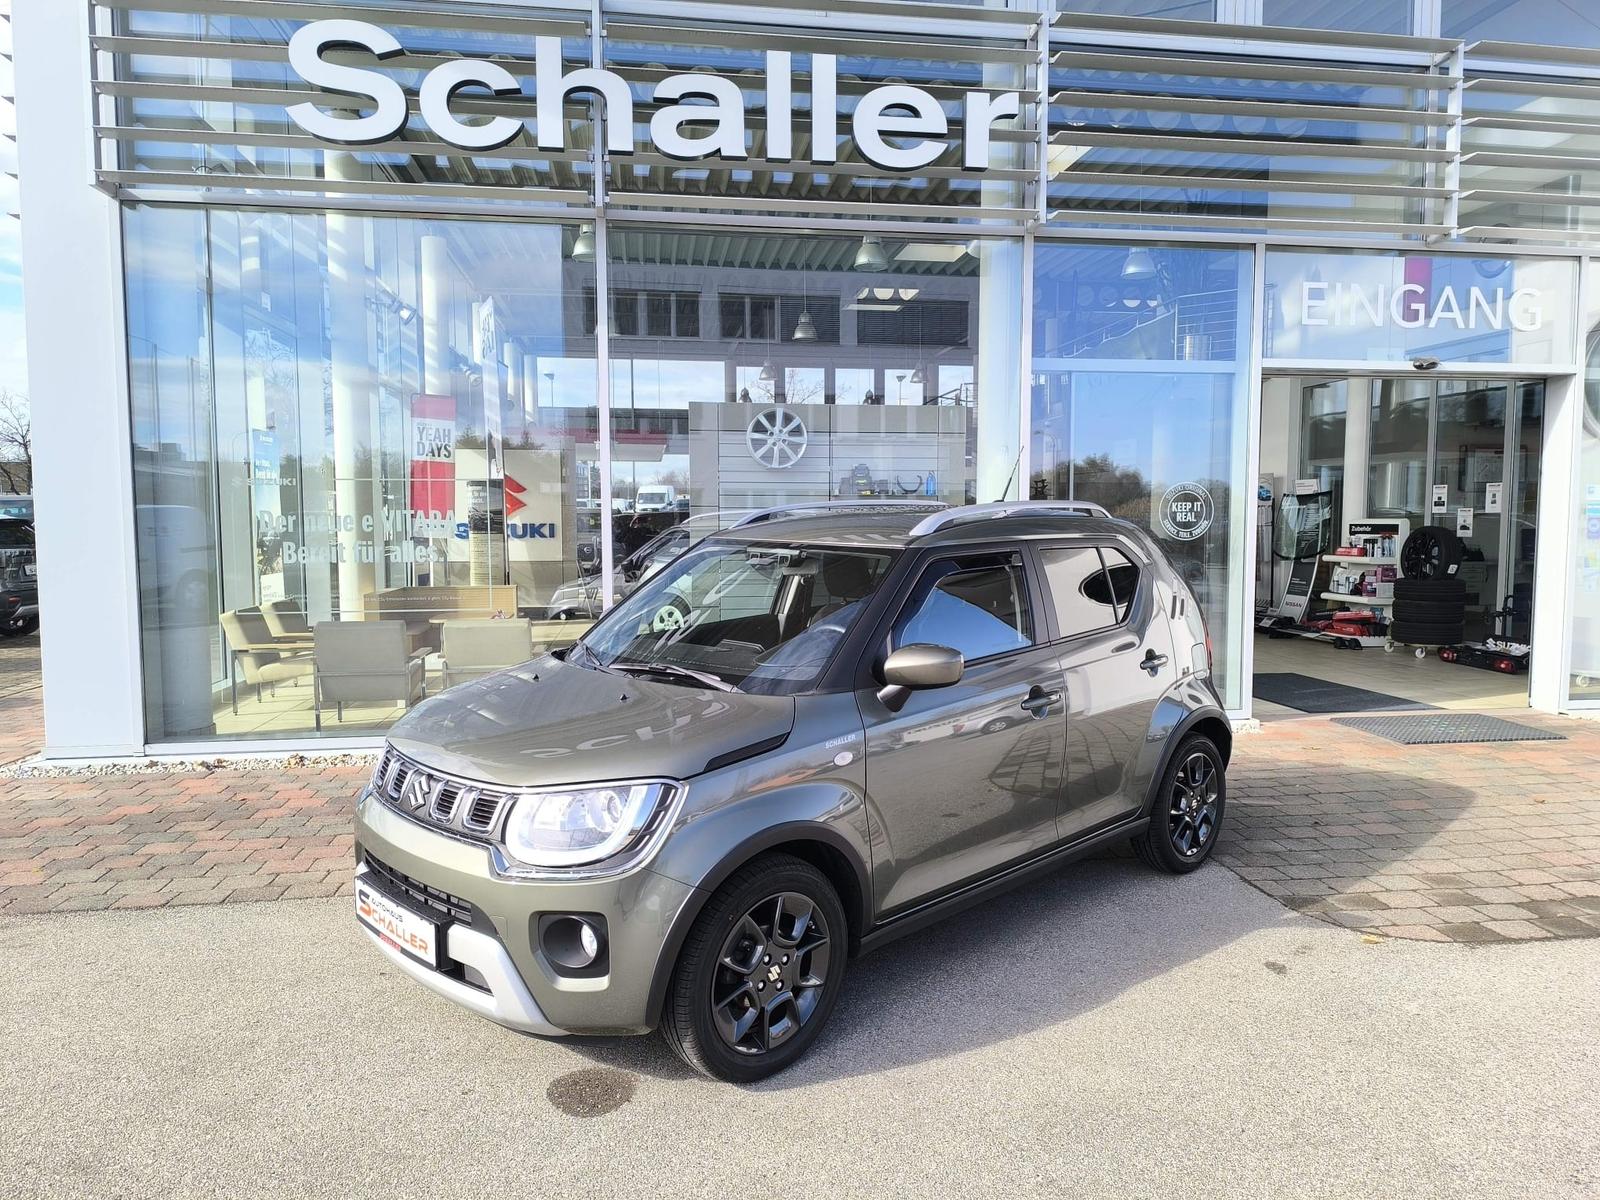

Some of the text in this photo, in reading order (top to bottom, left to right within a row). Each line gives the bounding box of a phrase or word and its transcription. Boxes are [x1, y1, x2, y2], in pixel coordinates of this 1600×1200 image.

[285, 19, 1020, 171] Schaller
[1301, 281, 1543, 332] EINGANG
[416, 426, 451, 443] YEAH
[416, 441, 452, 458] DAYS
[247, 477, 297, 486] SZUKI
[1171, 501, 1202, 512] KEEP IT
[259, 510, 297, 533] Der
[361, 513, 374, 533] e
[1176, 511, 1197, 522] REAL
[455, 522, 555, 539] SUKI
[825, 734, 856, 749] SCHALLER
